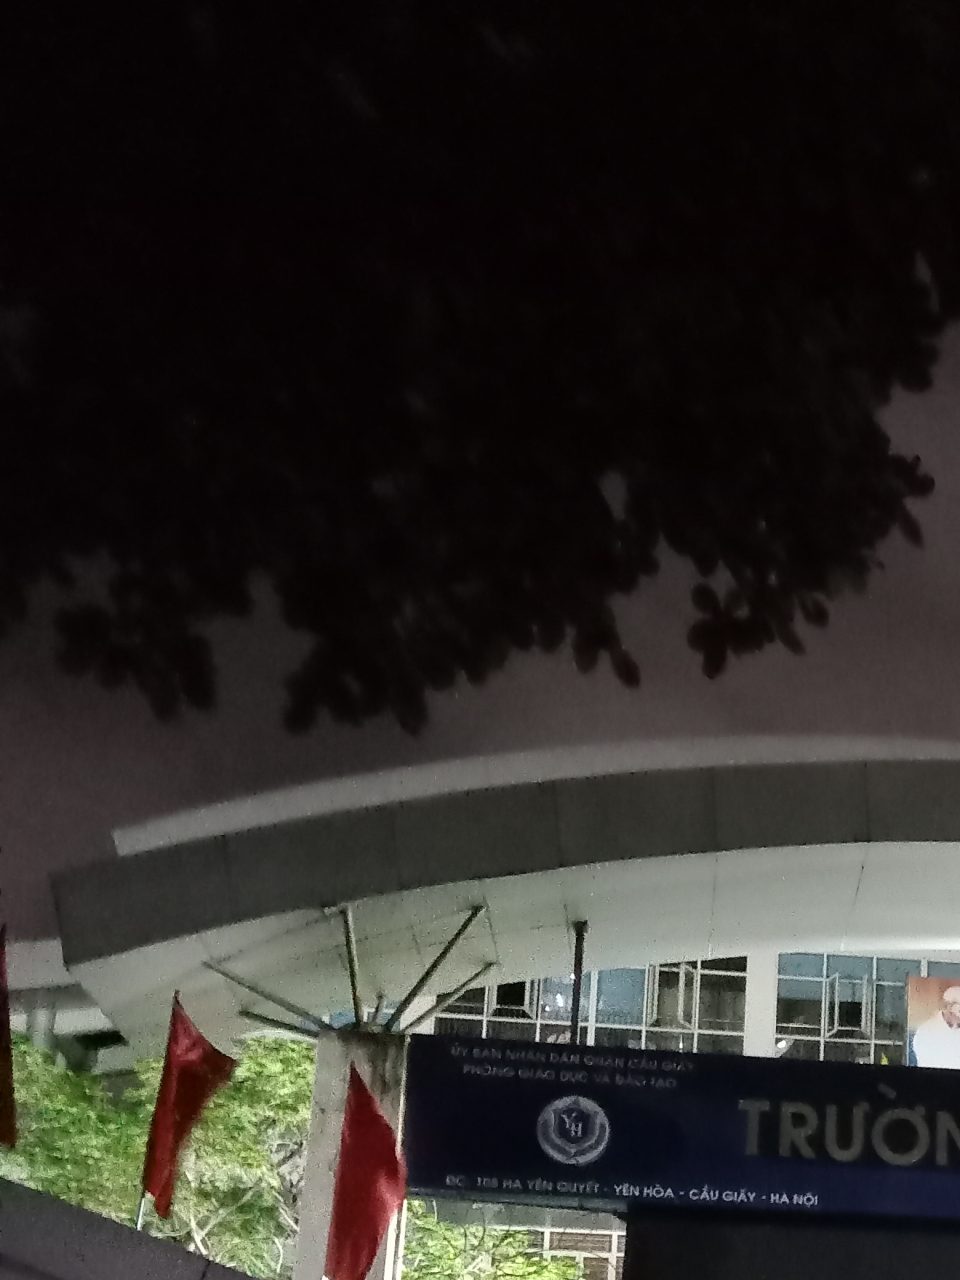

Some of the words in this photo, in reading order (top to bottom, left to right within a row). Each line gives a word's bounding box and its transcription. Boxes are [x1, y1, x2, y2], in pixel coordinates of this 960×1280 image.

[613, 1182, 640, 1198] YÊN
[643, 1183, 675, 1199] HÒA
[689, 1184, 719, 1201] CẦU
[722, 1187, 756, 1203] GIẤY
[792, 1192, 819, 1208] NỘI
